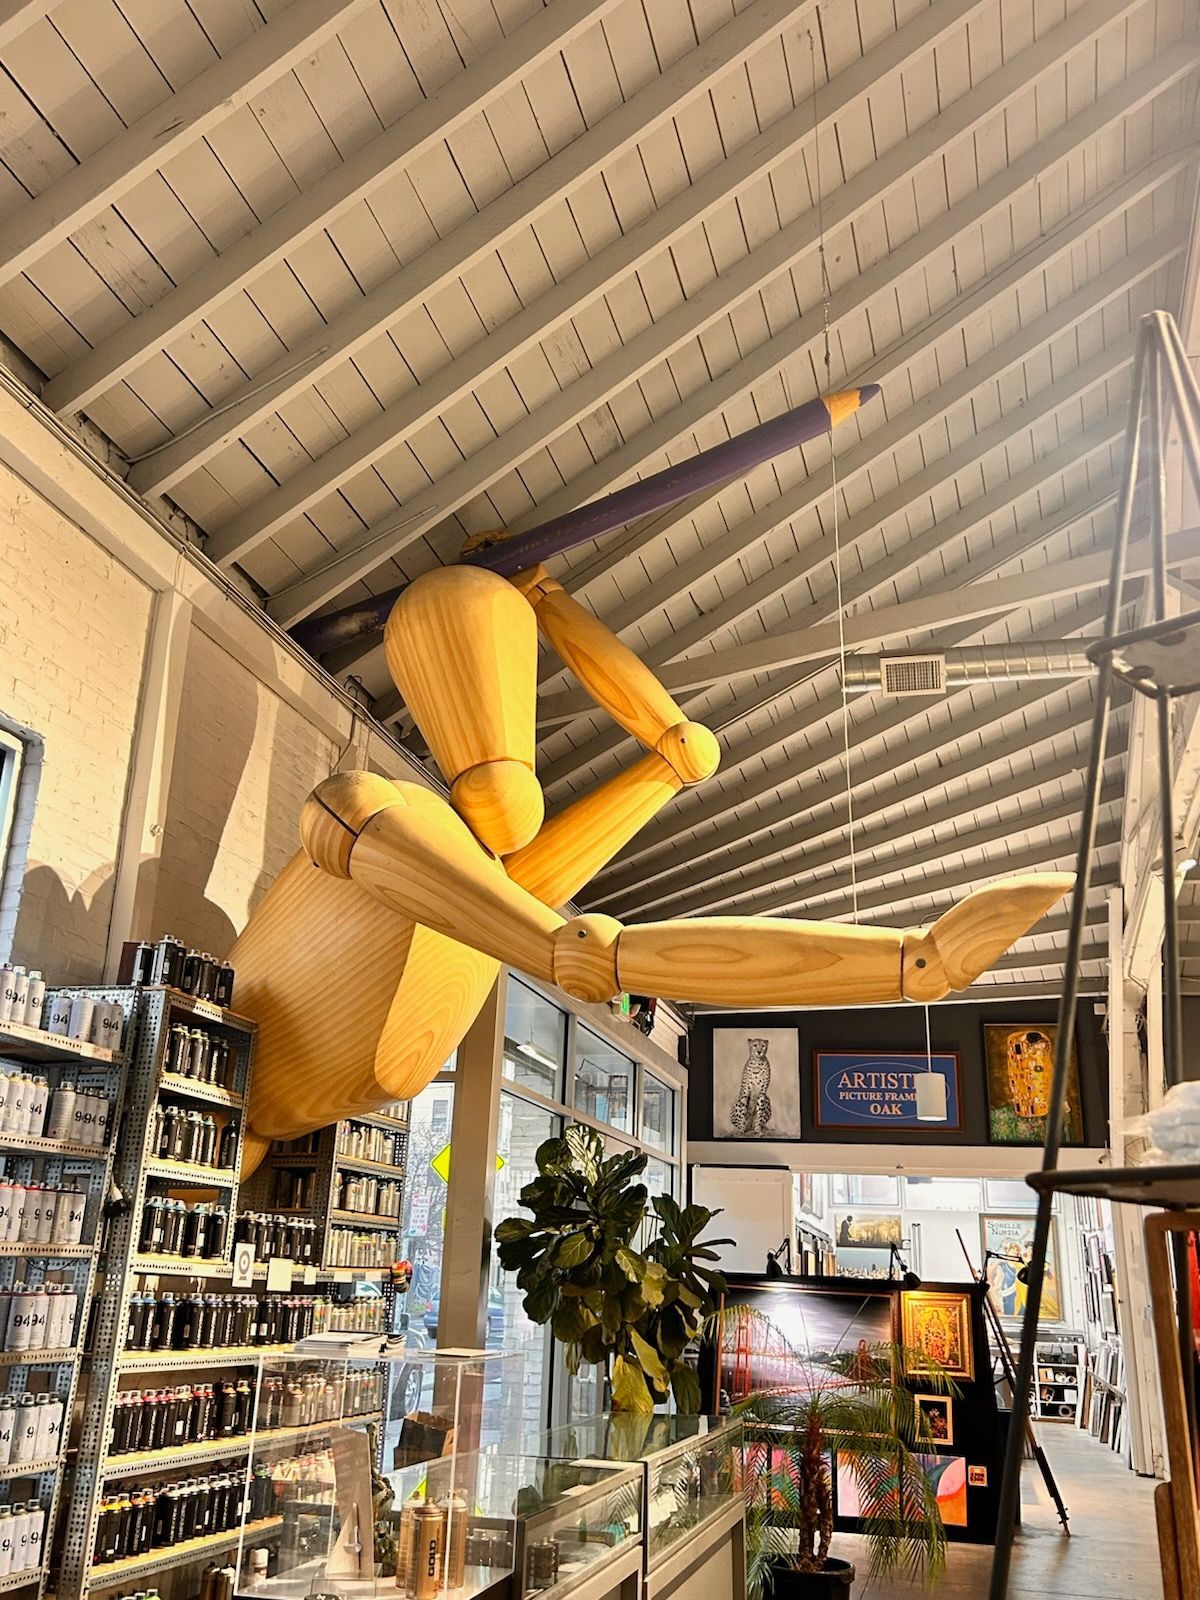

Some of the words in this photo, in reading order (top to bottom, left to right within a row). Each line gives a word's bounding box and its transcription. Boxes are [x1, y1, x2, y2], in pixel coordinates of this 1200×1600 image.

[53, 1013, 68, 1025] 94
[839, 1091, 883, 1101] PICTURE
[885, 1091, 918, 1101] FRAM
[869, 1102, 902, 1115] OAK
[13, 1314, 31, 1328] 94
